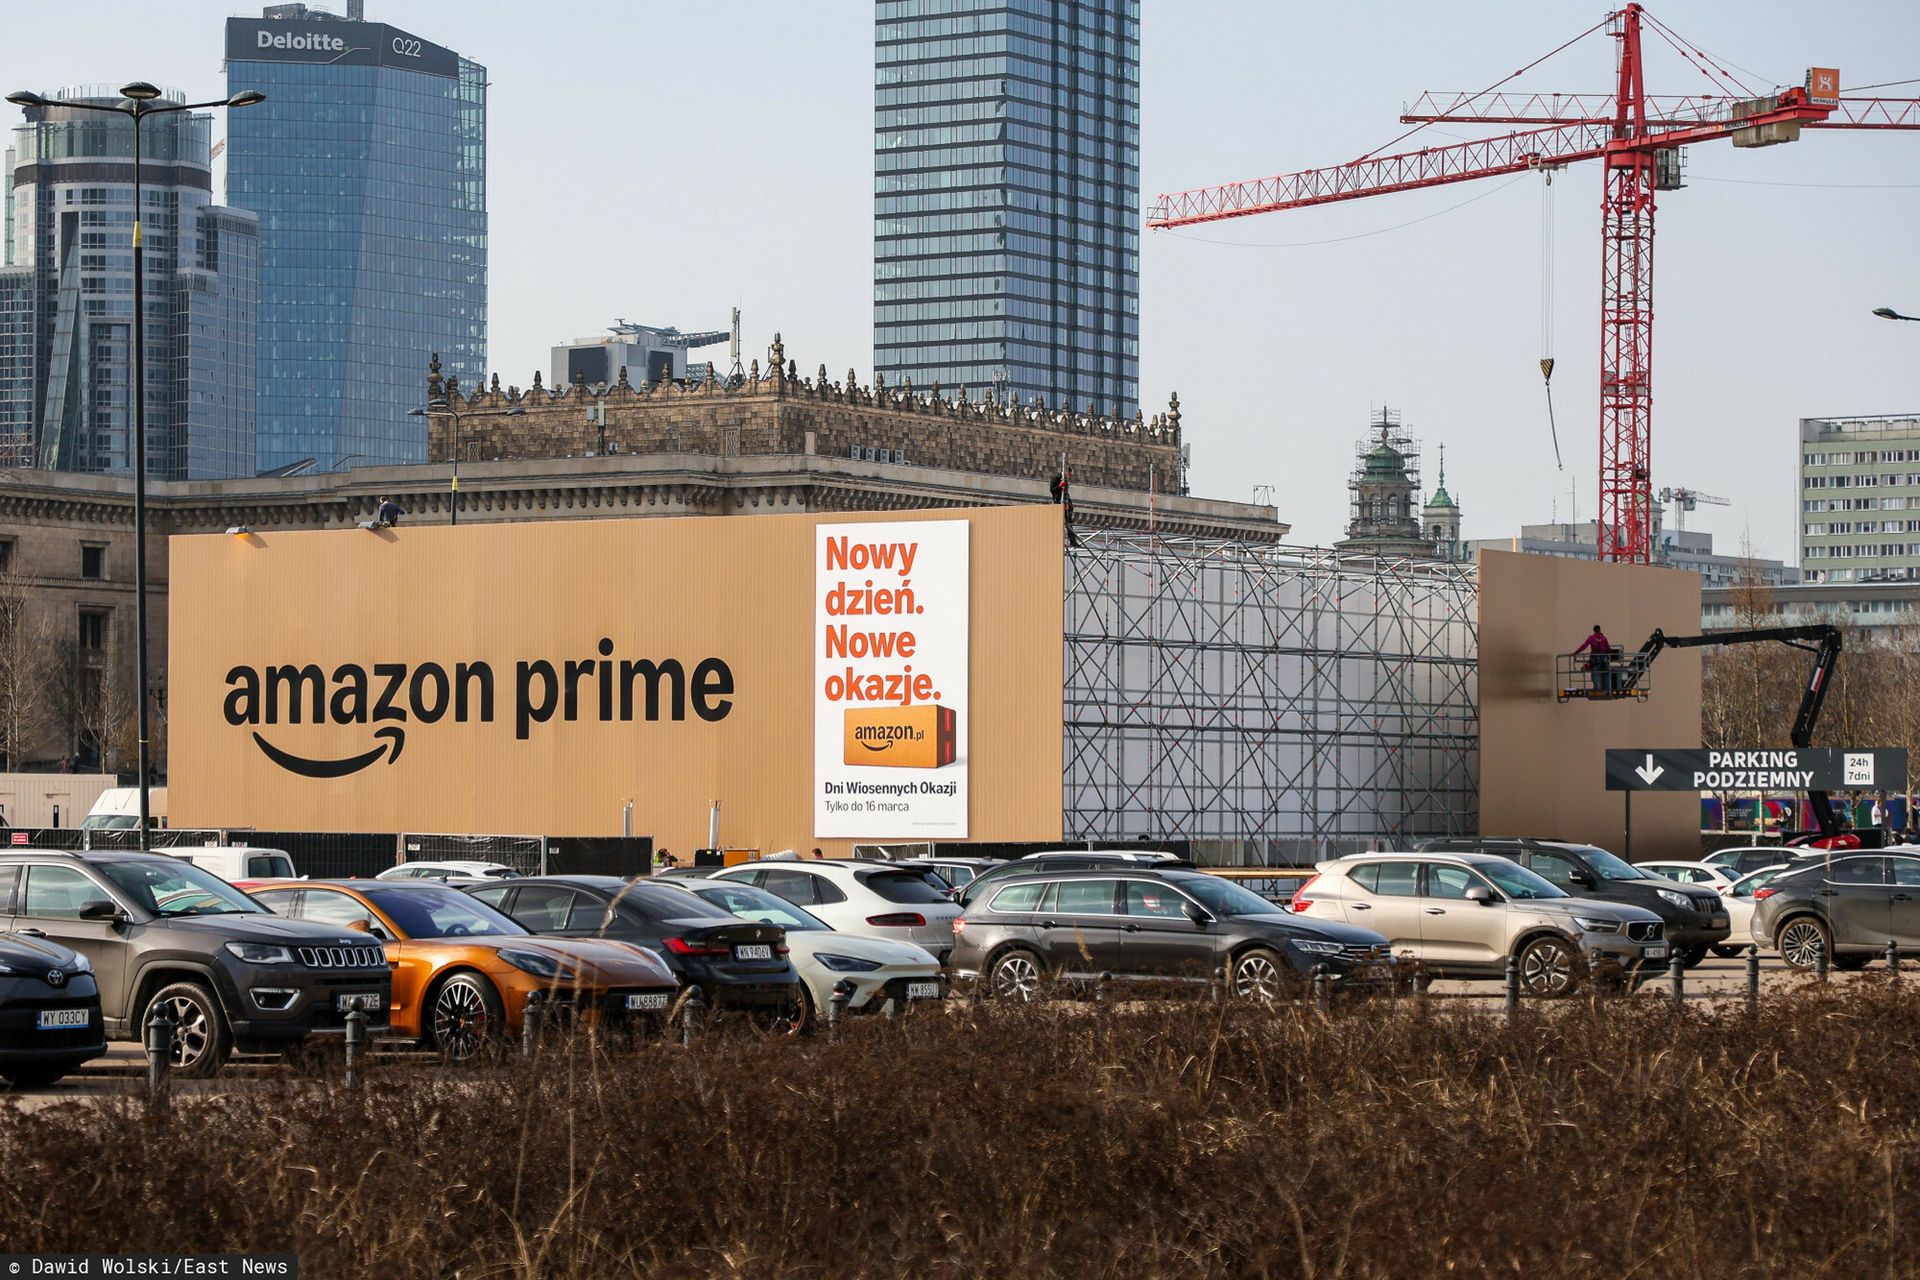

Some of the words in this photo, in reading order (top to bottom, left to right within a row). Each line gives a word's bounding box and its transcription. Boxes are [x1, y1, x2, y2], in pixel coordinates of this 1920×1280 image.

[392, 37, 422, 58] Q22
[826, 536, 918, 576] Nowy
[825, 579, 924, 616] dzień.
[826, 624, 916, 658] Nowe
[223, 661, 494, 726] amazon
[516, 637, 735, 740] prime
[825, 664, 942, 706] okazje.
[855, 725, 924, 741] amazon.pl
[1709, 751, 1798, 768] PARKING
[1849, 757, 1869, 768] 24h
[1693, 771, 1814, 788] PODZIEMNY
[1848, 771, 1871, 782] 7dni
[825, 781, 844, 794] Dni
[846, 781, 917, 797] Wiosennych
[920, 781, 957, 797] Okazji
[825, 801, 849, 813] Tylko
[851, 801, 863, 812] do
[866, 801, 876, 812] 16
[878, 803, 909, 812] marca
[43, 1012, 55, 1025] WY
